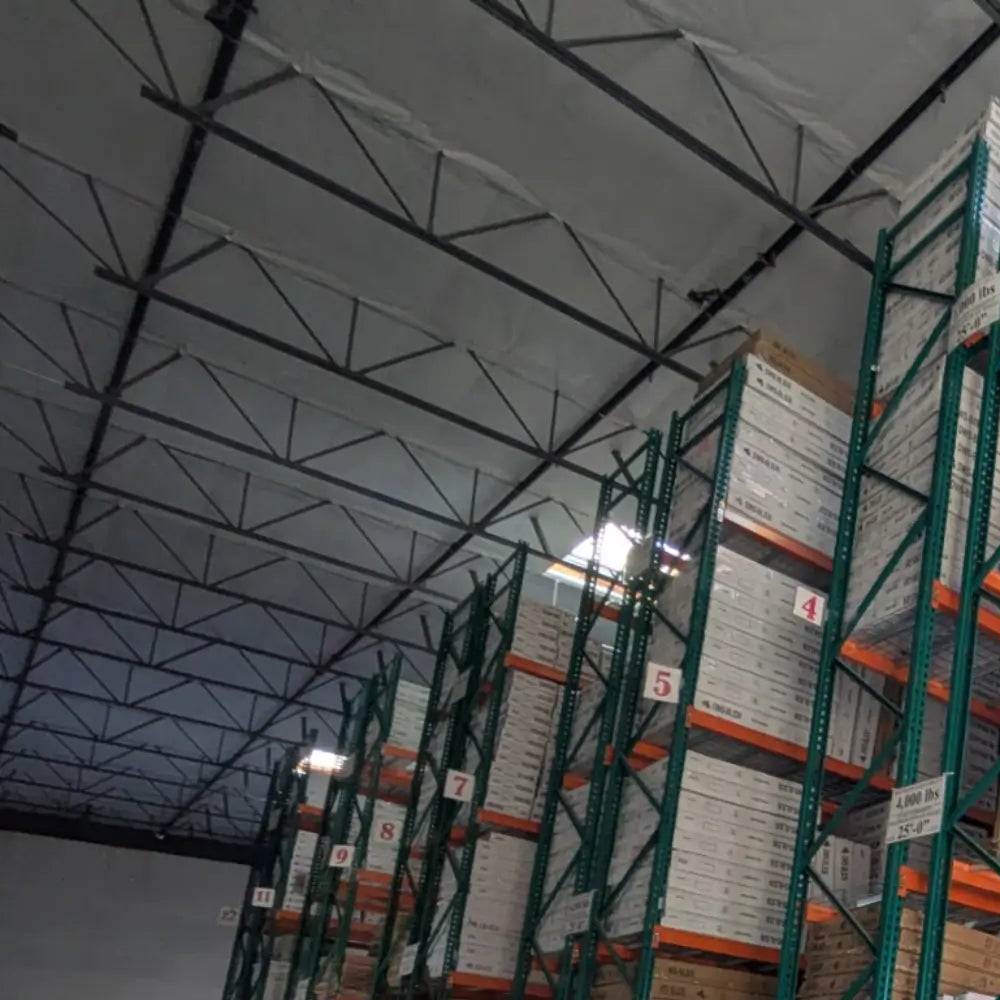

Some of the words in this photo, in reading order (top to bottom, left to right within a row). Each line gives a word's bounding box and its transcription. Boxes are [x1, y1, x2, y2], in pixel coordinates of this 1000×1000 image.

[801, 595, 817, 621] 4
[653, 670, 672, 697] 5
[454, 776, 468, 796] 7
[380, 823, 395, 840] 8
[336, 848, 348, 864] 9
